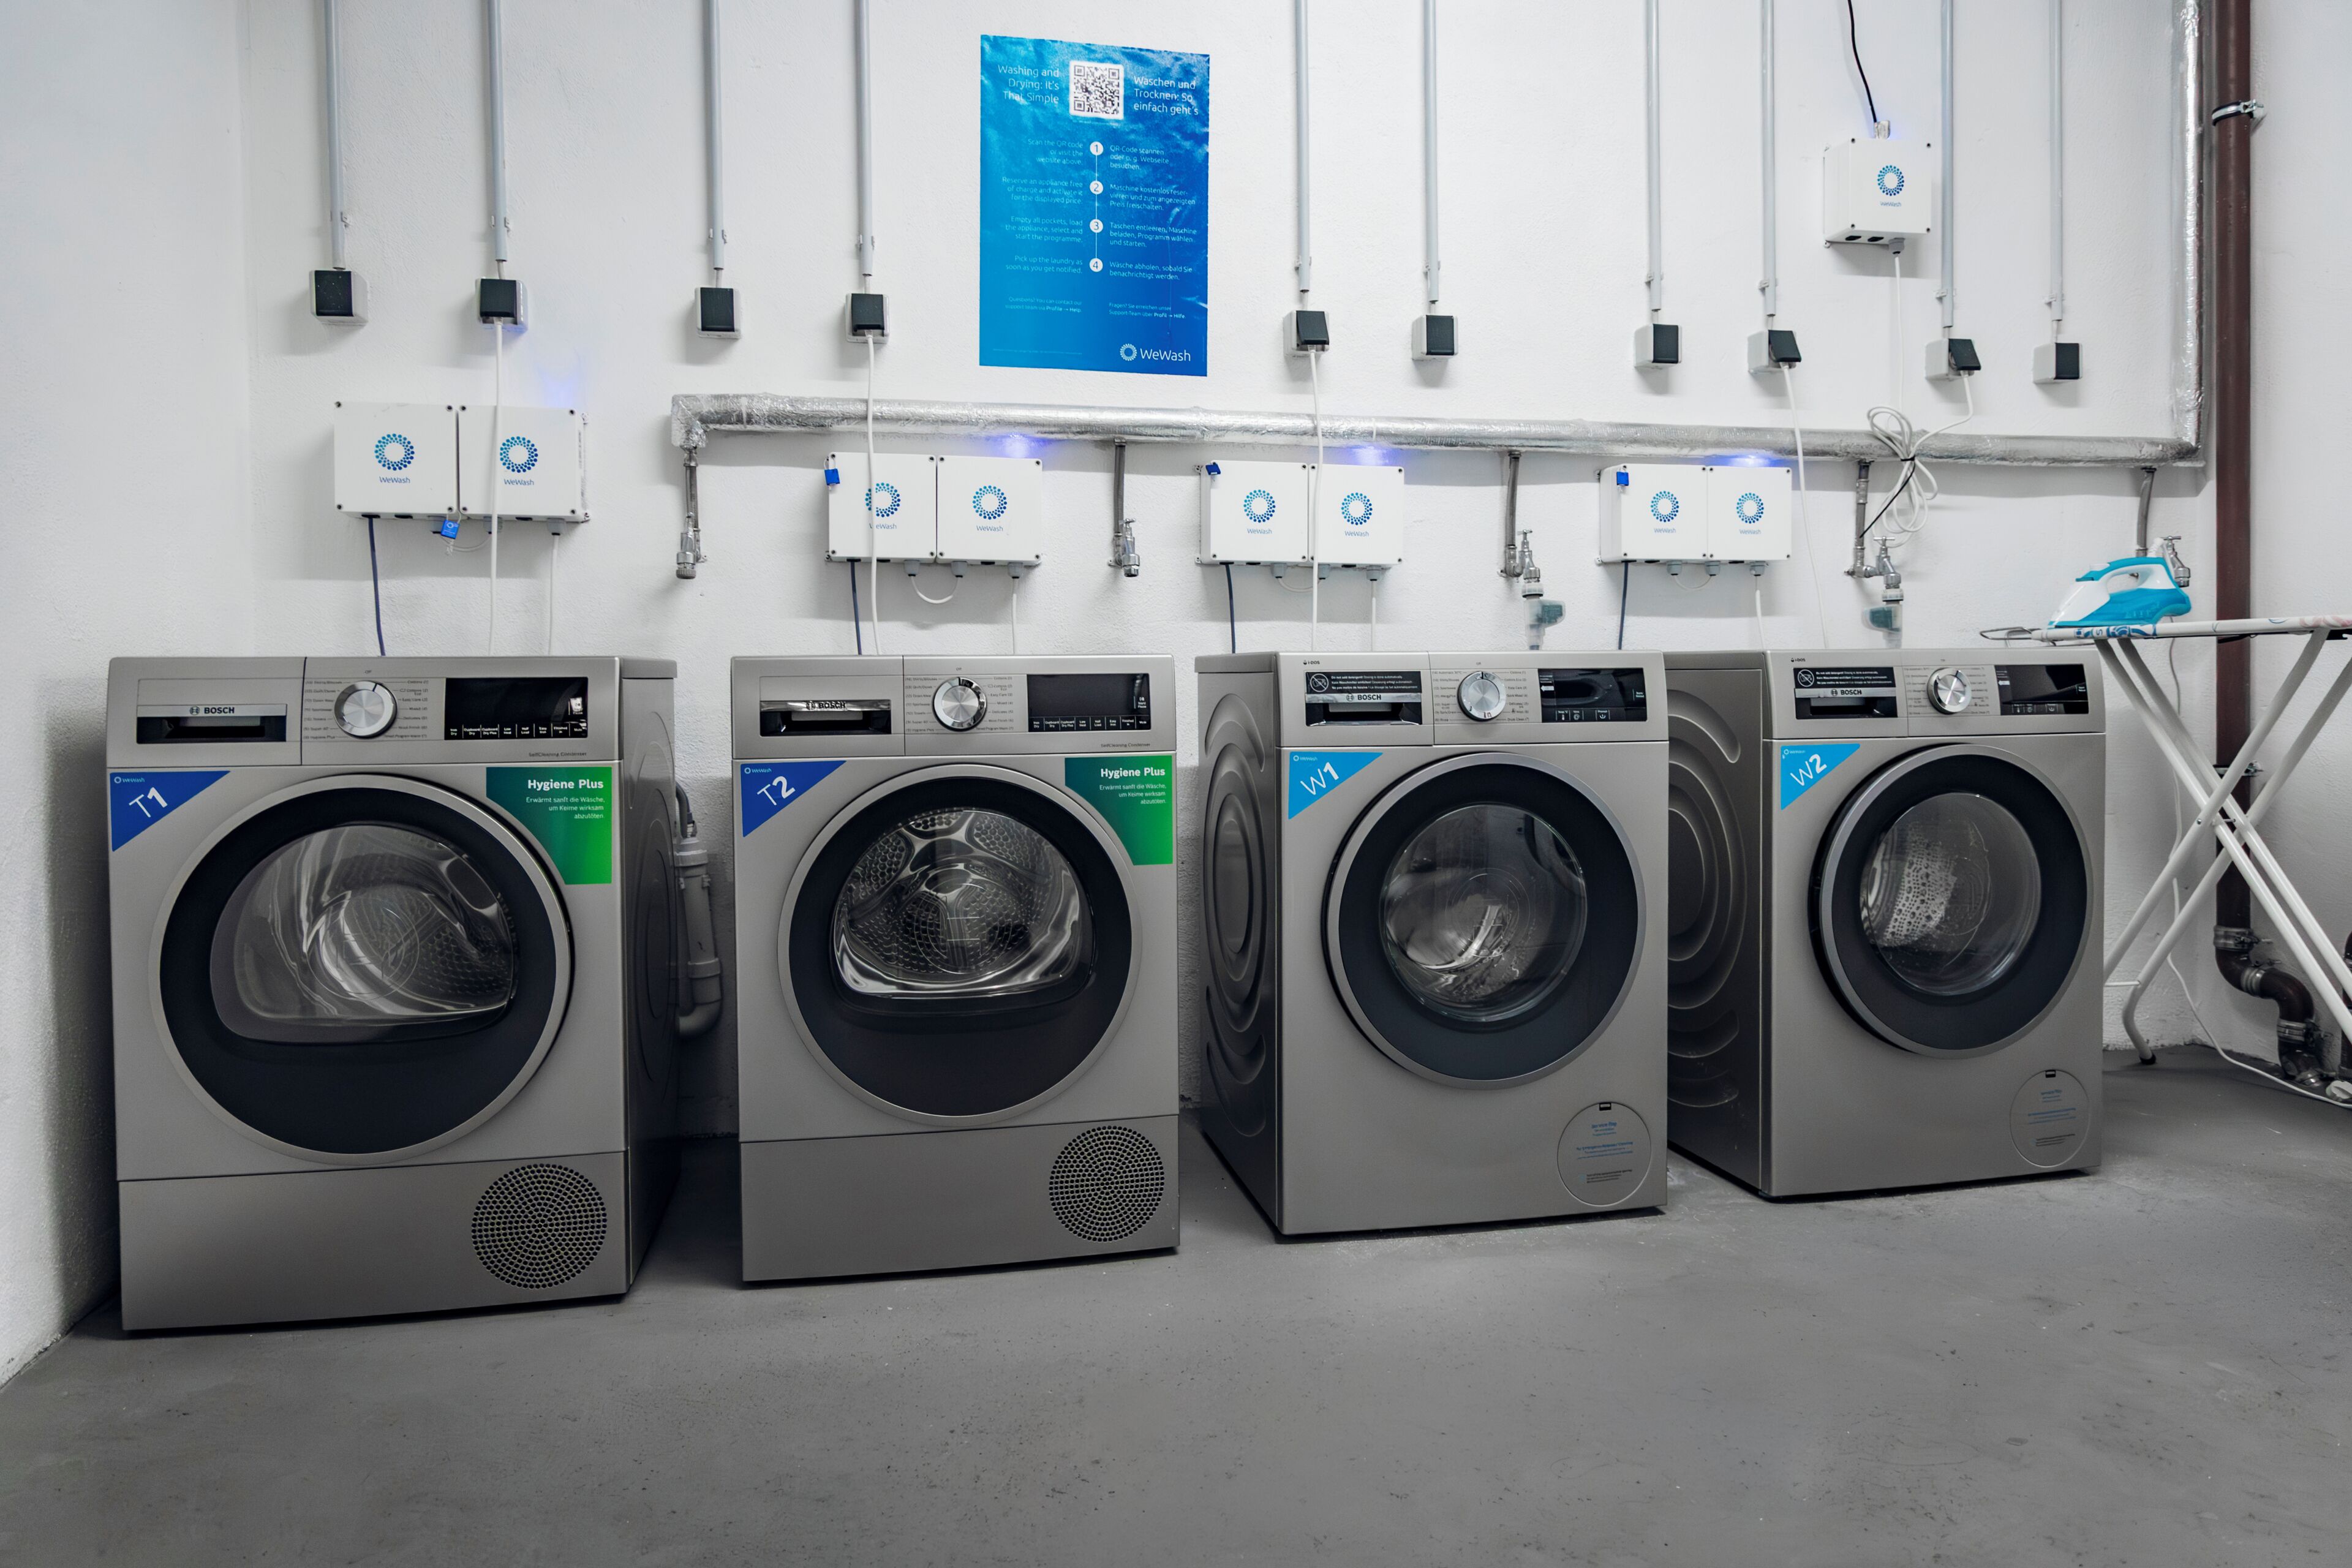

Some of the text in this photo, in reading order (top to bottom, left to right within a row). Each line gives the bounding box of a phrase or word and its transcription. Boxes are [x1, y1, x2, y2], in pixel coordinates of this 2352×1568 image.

[998, 65, 1059, 78] Washing and
[1009, 78, 1059, 91] Drying: It's
[1134, 76, 1196, 89] Waschen und
[1003, 91, 1059, 104] That Simple
[1134, 89, 1193, 102] Trocknen: So
[1134, 102, 1198, 115] einfach geht's
[1094, 183, 1099, 192] 2
[1126, 202, 1164, 210] freischalten.
[1094, 222, 1099, 230] 3
[1136, 224, 1167, 233] entleeren,
[1093, 261, 1098, 270] 4
[1110, 270, 1153, 280] benachrichtigt
[1140, 349, 1191, 361] WeWash
[1101, 767, 1166, 779] Hygiene Plus
[1790, 754, 1827, 786] W2
[528, 779, 603, 791] Hygiene Plus
[1300, 762, 1339, 795] W1
[757, 776, 795, 805] T2
[129, 787, 168, 818] T1
